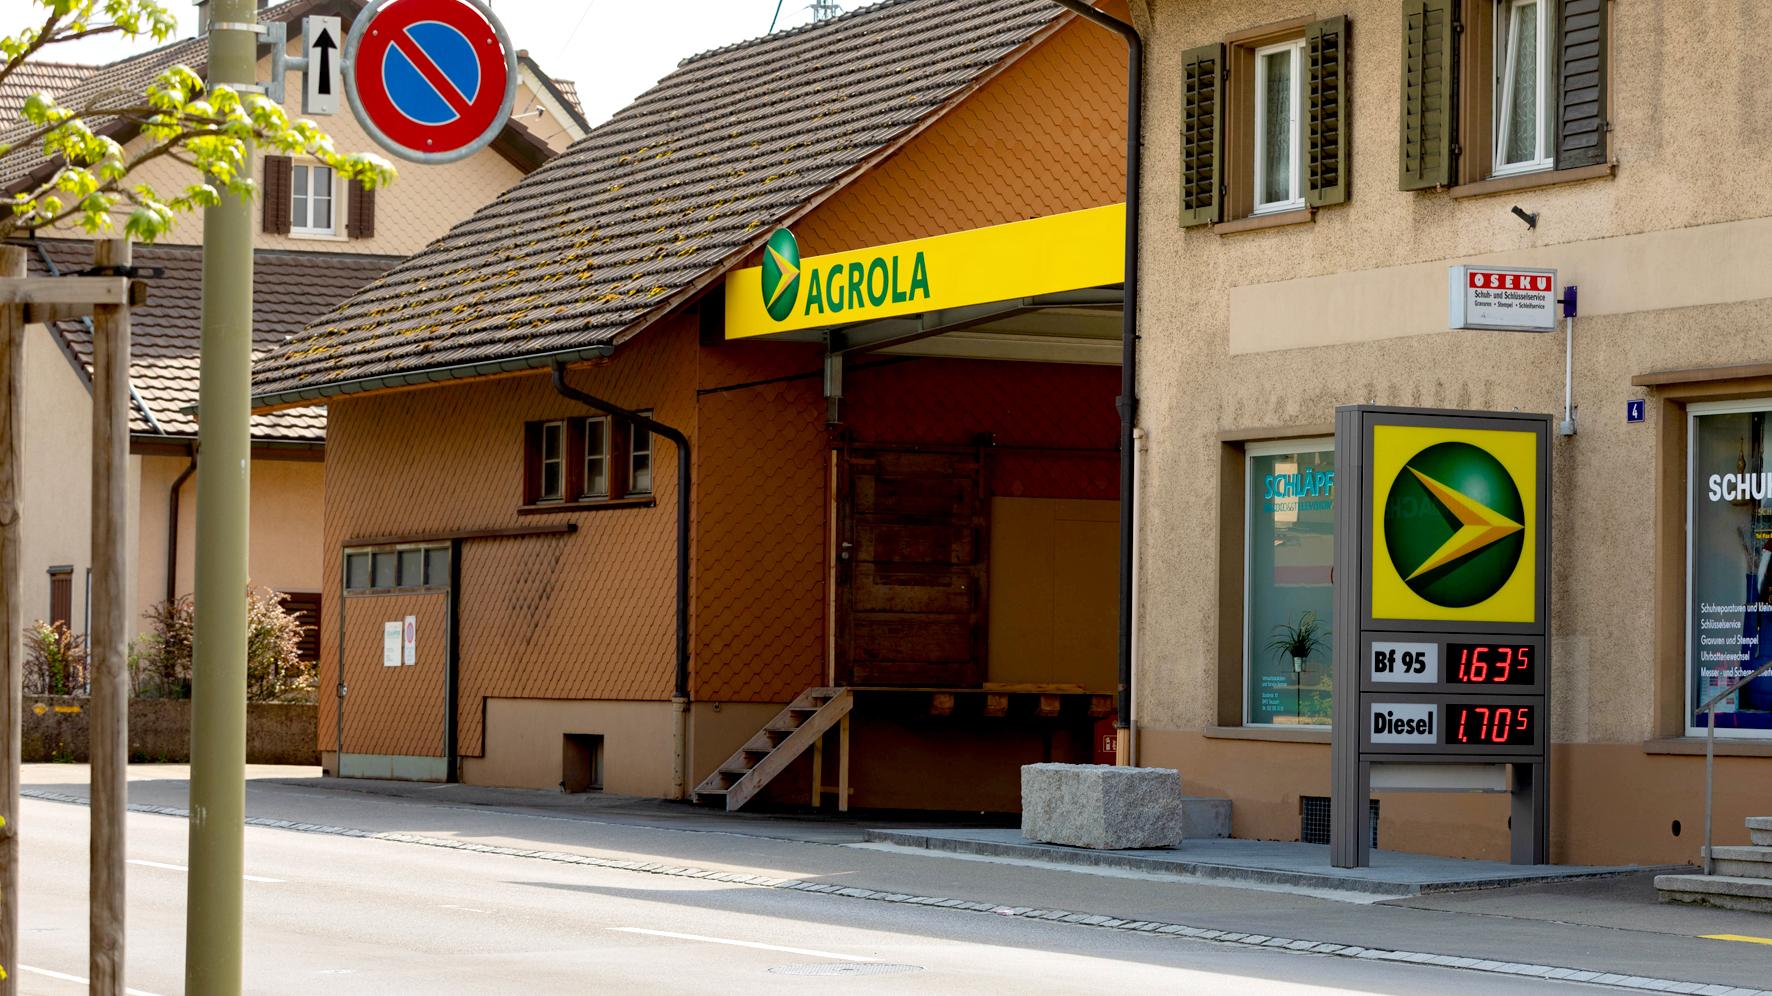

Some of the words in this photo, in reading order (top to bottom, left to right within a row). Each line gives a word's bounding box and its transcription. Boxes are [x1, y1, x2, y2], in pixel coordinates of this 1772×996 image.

[804, 251, 930, 316] AGROLA
[1474, 273, 1547, 290] OSEKU
[1474, 290, 1492, 299] Schuh-
[1493, 291, 1503, 299] und
[1504, 291, 1545, 301] Schlüsselservice
[1632, 403, 1638, 419] 4
[1700, 602, 1746, 616] Schuhreparaturen
[1747, 602, 1758, 612] und
[1700, 619, 1741, 629] Schlüsselservice
[1700, 635, 1725, 645] Gravuren
[1726, 635, 1736, 645] und
[1737, 634, 1759, 647] Stempel
[1374, 649, 1396, 673] Bf
[1401, 651, 1426, 674] 95
[1700, 650, 1750, 661] Uhrbatteriewechsel
[1373, 710, 1434, 735] Diesel
